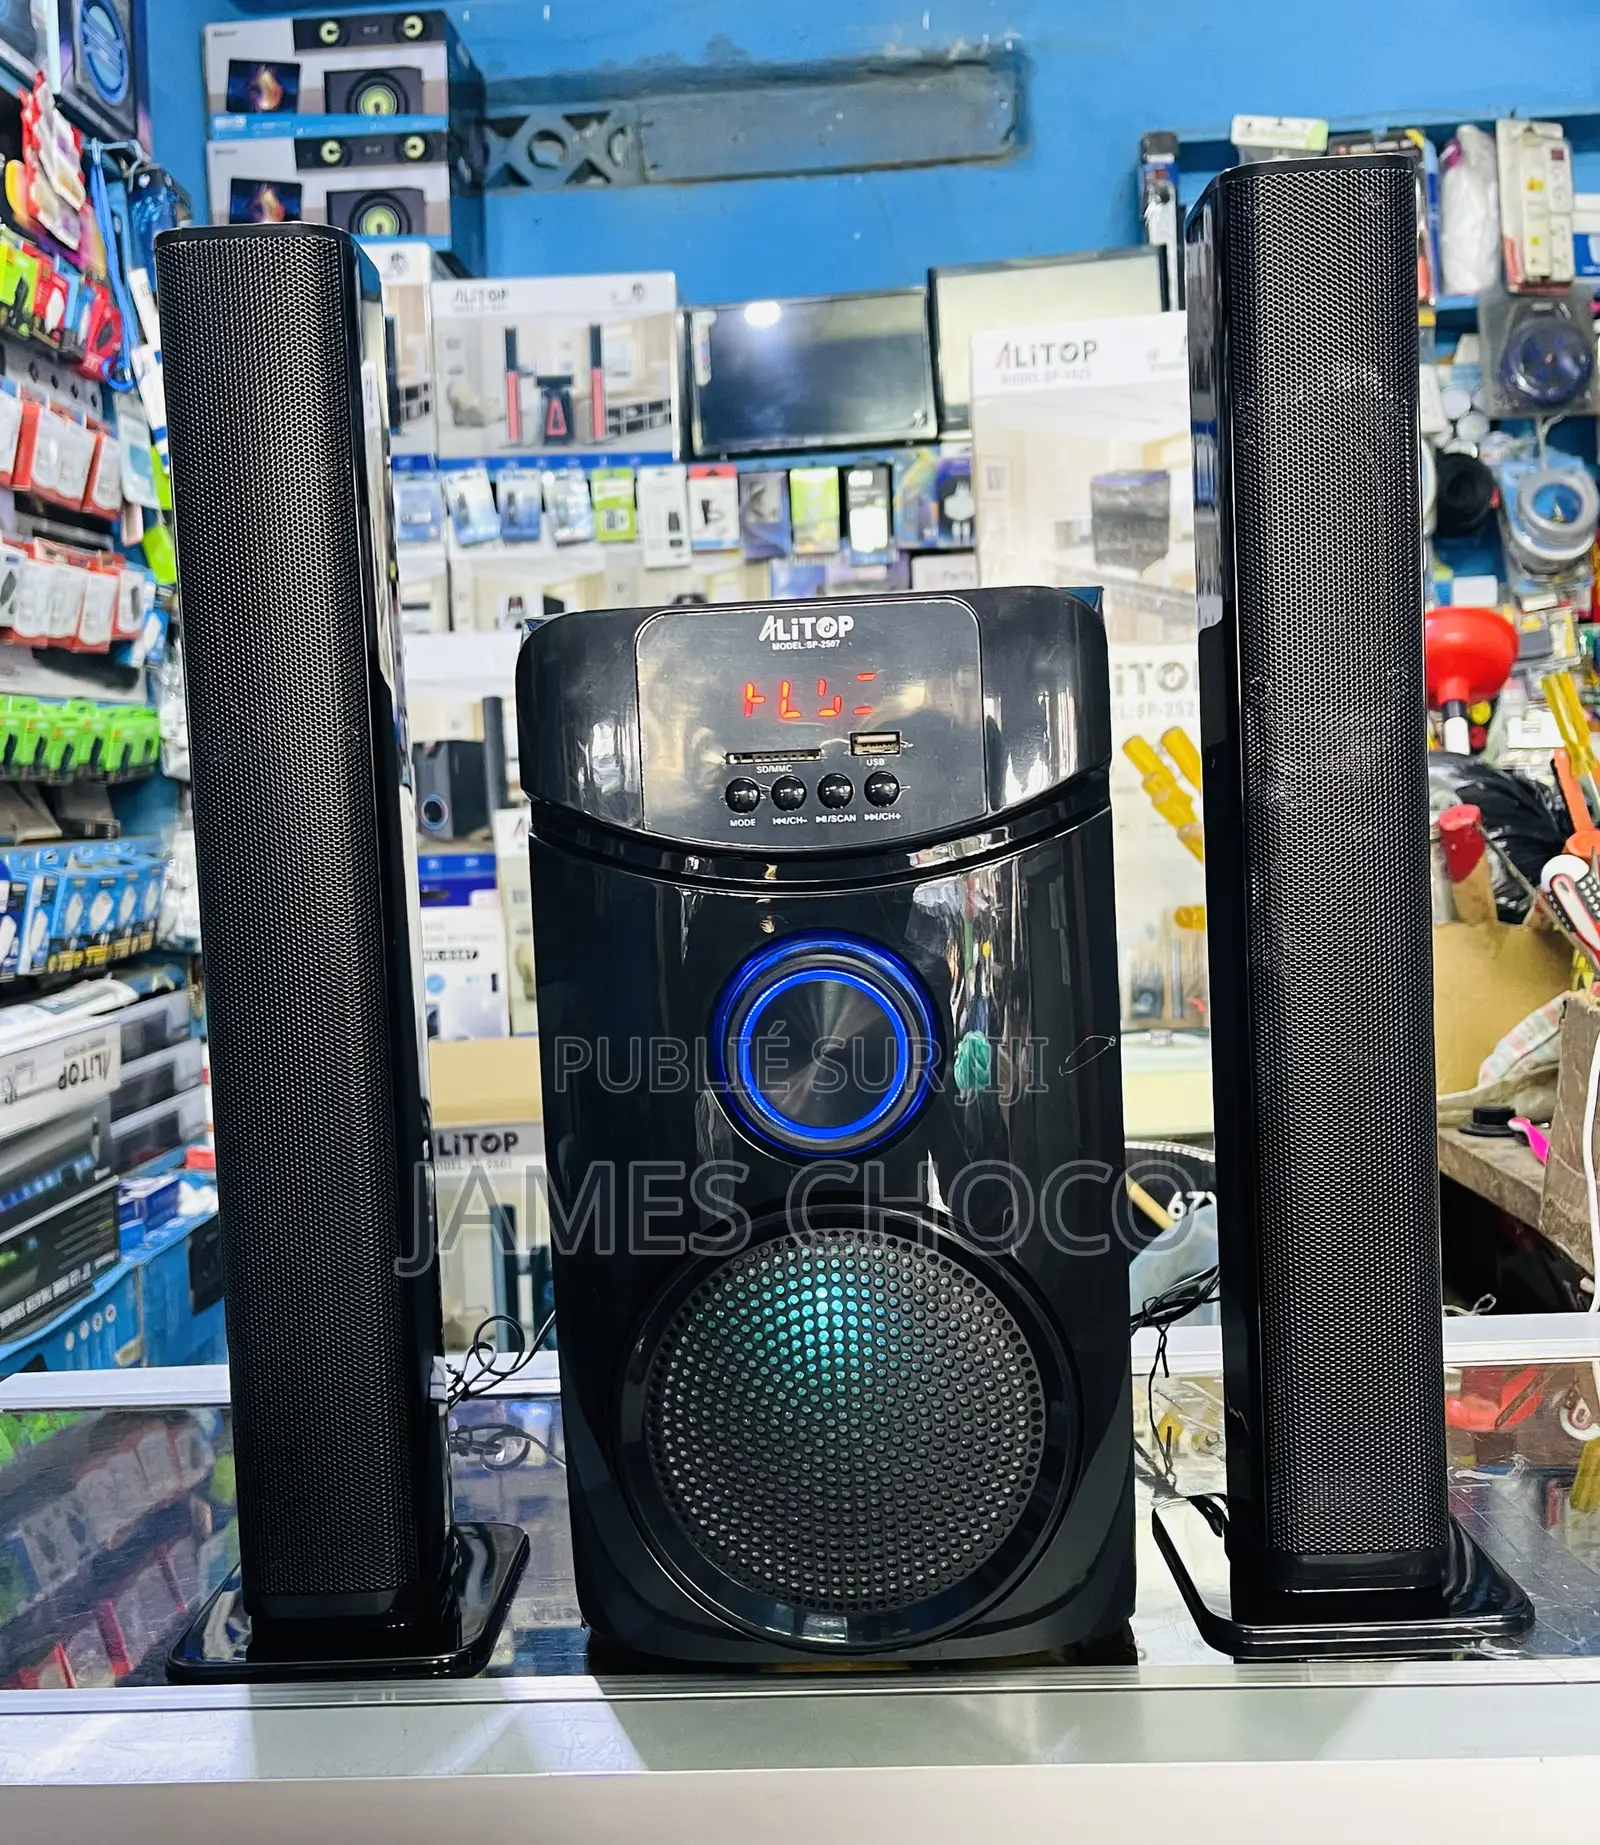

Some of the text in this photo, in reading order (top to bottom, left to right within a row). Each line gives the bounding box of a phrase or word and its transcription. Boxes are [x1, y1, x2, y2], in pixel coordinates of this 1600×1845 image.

[772, 640, 841, 650] MODEL:SP-2507
[866, 758, 885, 767] USB
[756, 765, 793, 774] SD/MMC
[729, 818, 757, 827] MODE
